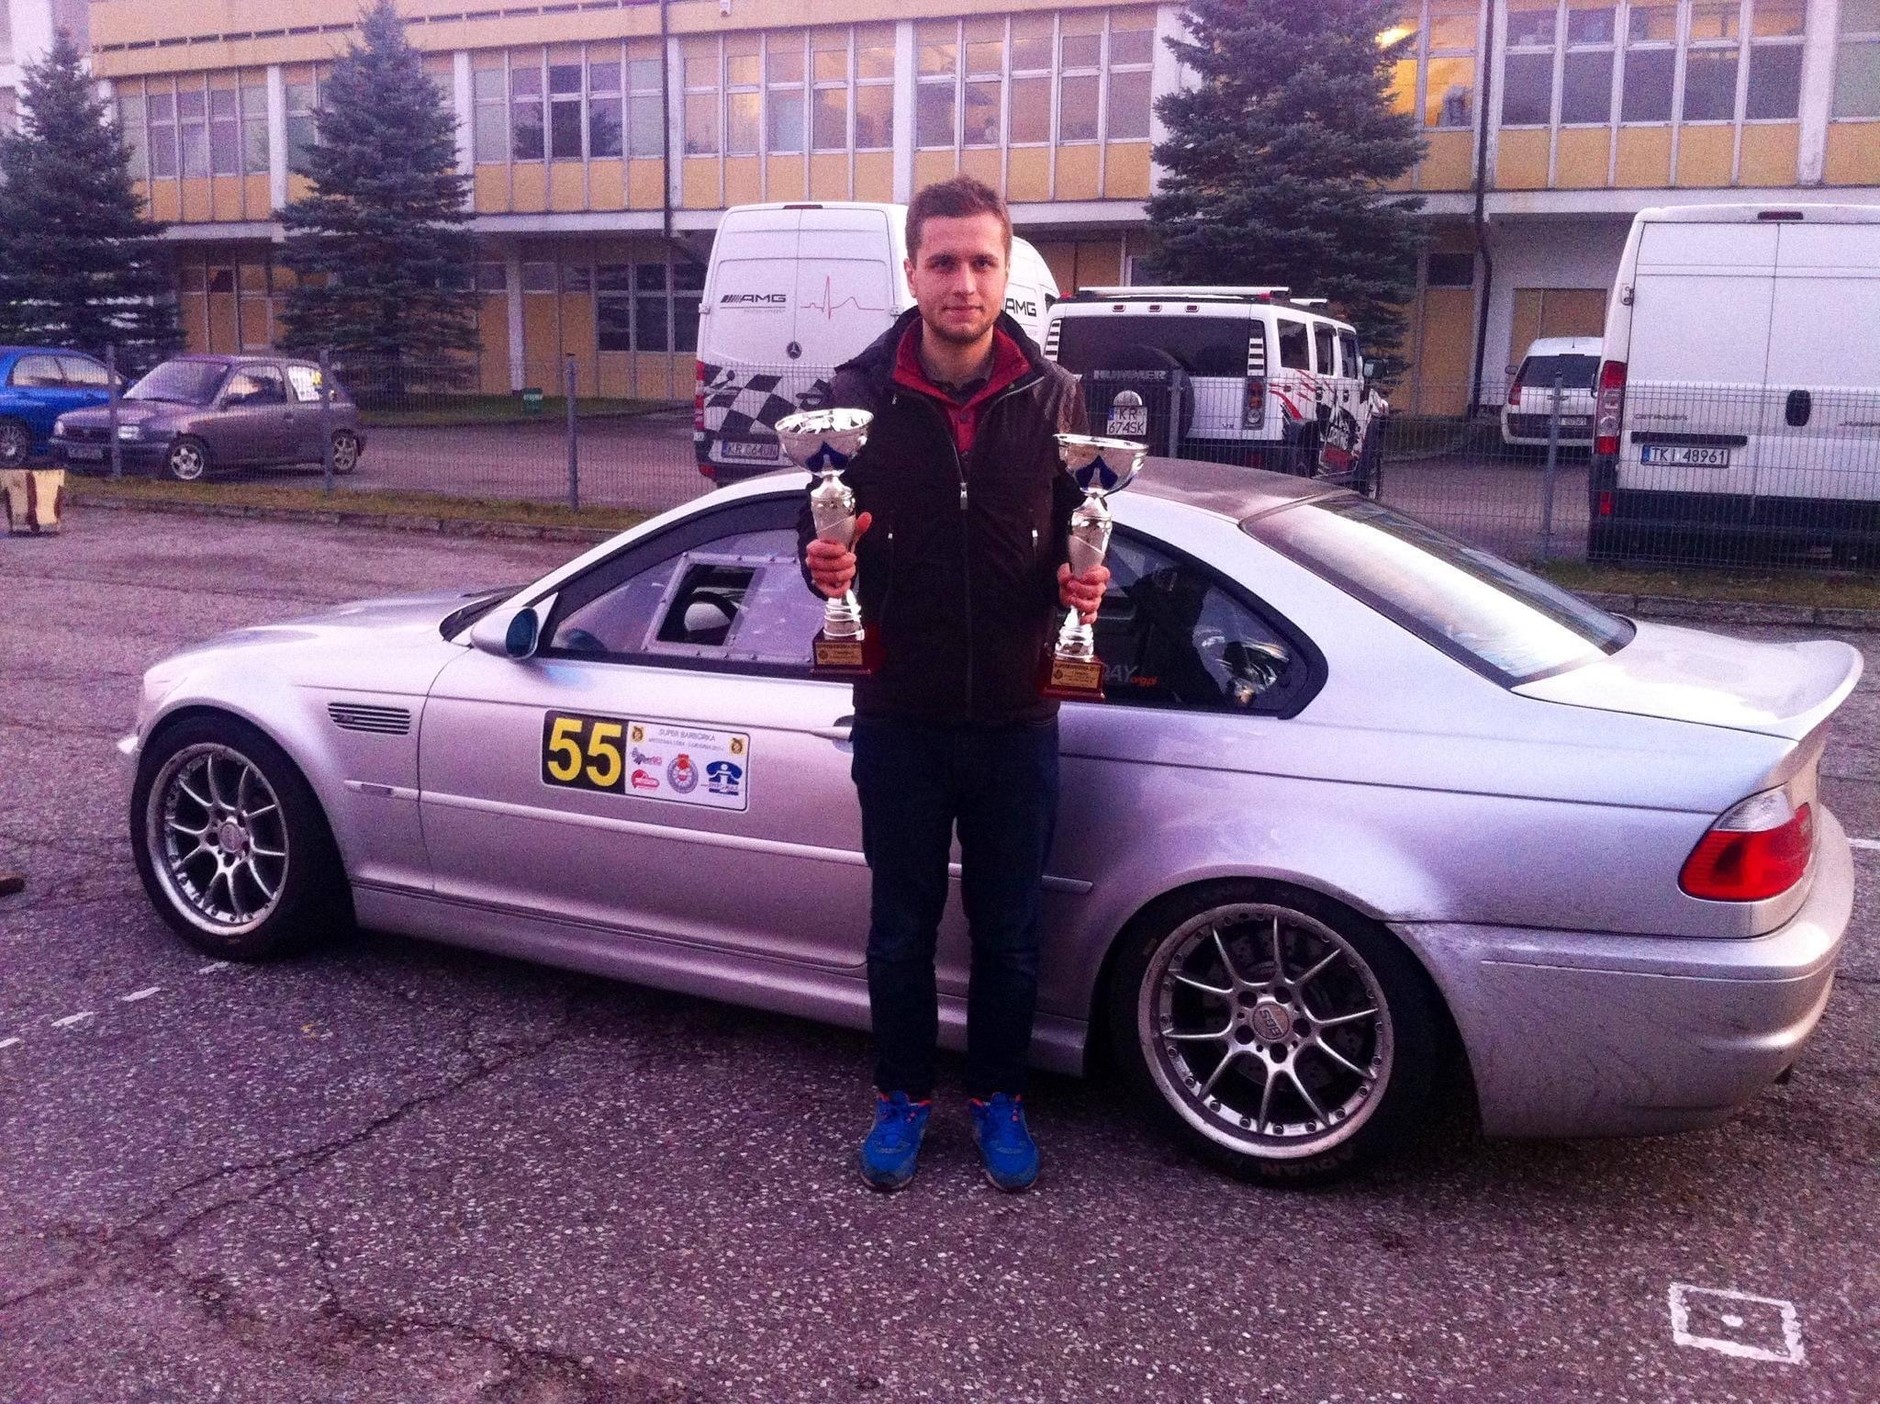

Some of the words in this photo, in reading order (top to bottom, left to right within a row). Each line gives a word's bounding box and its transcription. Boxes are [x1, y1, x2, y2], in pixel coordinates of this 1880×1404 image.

[1004, 297, 1037, 317] AMG
[1119, 407, 1138, 420] KR
[1108, 421, 1145, 434] 674SK
[1652, 447, 1676, 461] TKI
[1682, 448, 1725, 463] 48961
[547, 717, 622, 787] 55
